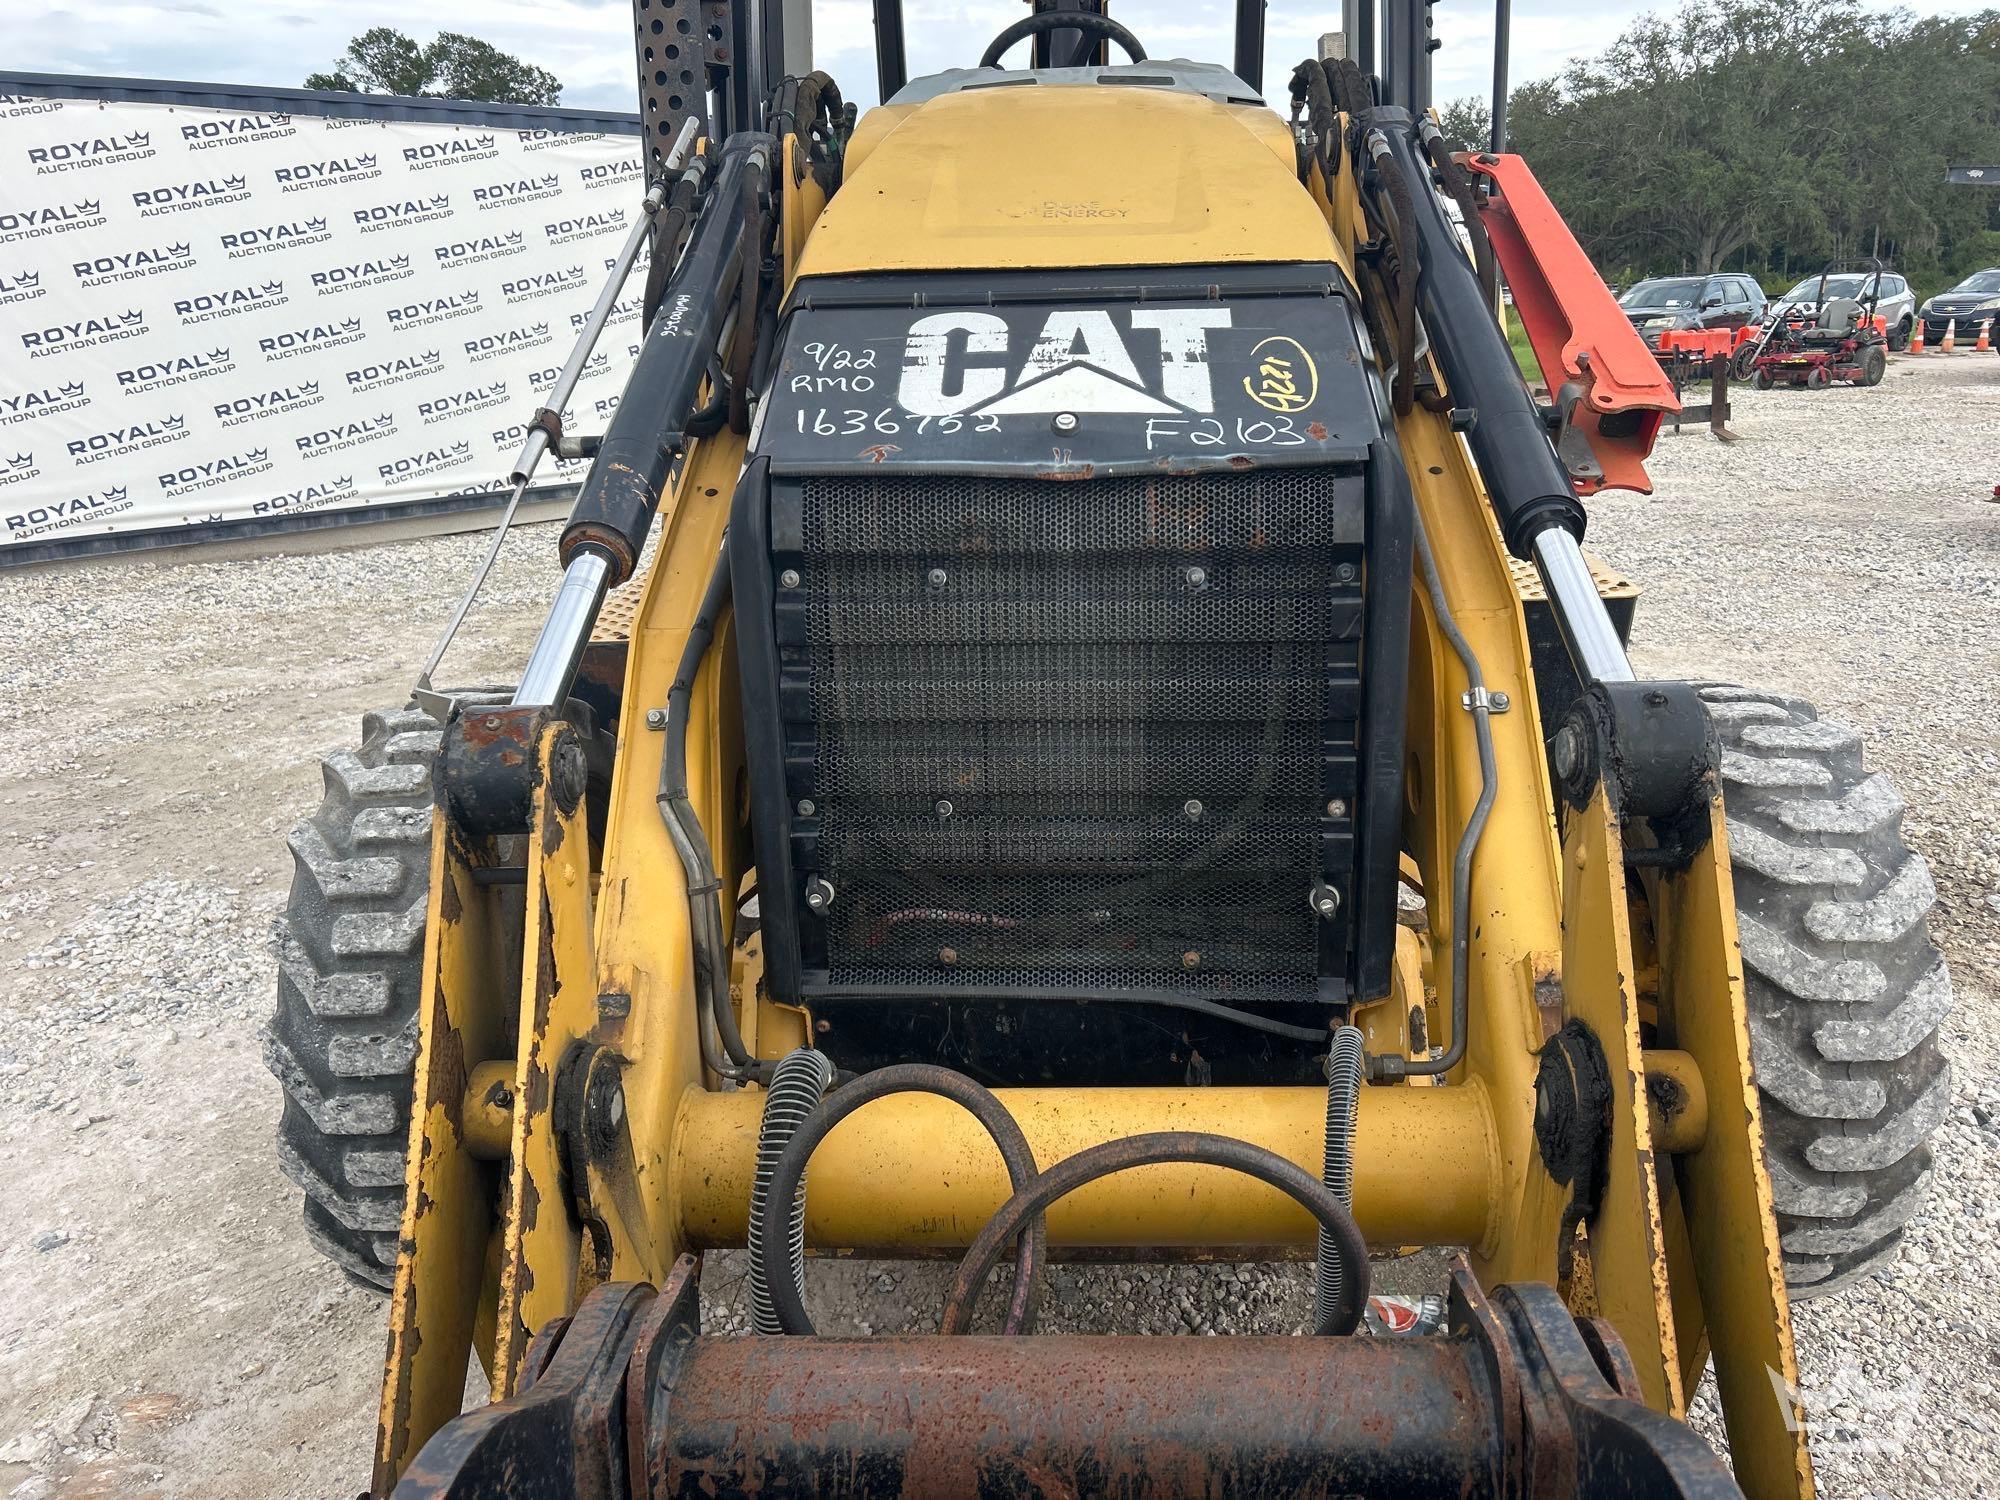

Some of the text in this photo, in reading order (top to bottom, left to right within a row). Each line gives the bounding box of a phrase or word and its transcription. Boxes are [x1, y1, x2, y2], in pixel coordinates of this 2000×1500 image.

[10, 103, 63, 116] GROUP
[181, 116, 271, 140] ROYAL
[190, 128, 296, 151] AUCTION GROUP
[28, 138, 127, 164] ROYAL
[403, 140, 477, 161] ROYAL
[524, 139, 568, 152] AUCTION
[570, 133, 606, 144] GROUP
[38, 150, 156, 175] AUCTION GROUP
[275, 159, 358, 182] ROYAL
[410, 151, 498, 171] AUCTION GROUP
[580, 160, 642, 180] ROYAL
[132, 181, 225, 207] ROYAL
[282, 170, 382, 193] AUCTION GROUP
[473, 179, 542, 201] ROYAL
[586, 177, 627, 188] AUCTION
[141, 192, 251, 217] AUCTION GROUP
[354, 200, 431, 224] ROYAL
[480, 189, 562, 210] AUCTION GROUP
[0, 206, 77, 230] OYAL
[361, 210, 454, 234] AUCTION GROUP
[545, 214, 609, 236] ROYAL
[1043, 209, 1129, 218] ENERGY
[0, 218, 106, 243] CTION GROUP
[220, 223, 307, 248] ROYAL
[550, 223, 627, 245] AUCTION GROUP
[229, 234, 332, 259] AUCTION GROUP
[435, 236, 506, 260] ROYAL
[441, 246, 526, 270] AUCTION GROUP
[73, 249, 169, 277] ROYAL
[82, 260, 196, 288] AUCTION GROUP
[311, 258, 391, 286] ROYAL
[318, 270, 414, 296] AUCTION GROUP
[502, 272, 568, 295] ROYAL
[508, 280, 587, 304] AUCTION GROUP
[174, 287, 263, 315] ROYAL
[182, 297, 288, 325] AUCTION GROUP
[387, 297, 461, 322] ROYAL
[570, 302, 632, 326] RAL
[394, 305, 482, 332] AUCTION GROUP
[21, 317, 121, 348] ROYAL
[31, 327, 149, 359] AUCTION GROUP
[259, 325, 342, 352] ROYAL
[464, 329, 533, 354] ROYAL
[267, 333, 366, 362] AUCTION GROUP
[470, 336, 552, 362] AUCTION GROUP
[804, 342, 876, 371] 9/22
[116, 355, 209, 385] ROYAL
[346, 357, 422, 384] ROYAL
[898, 307, 1231, 416] CAT
[125, 364, 236, 396] AUCTION GROUP
[353, 365, 444, 394] AUCTION GROUP
[791, 374, 874, 392] RMO
[0, 390, 61, 414] YAL
[0, 398, 90, 425] TION GROUP
[214, 388, 300, 418] ROYAL
[222, 396, 324, 428] AUCTION GROUP
[418, 389, 490, 416] ROYAL
[424, 396, 510, 424] AUCTION GROUP
[797, 407, 1002, 436] 1636752
[1146, 416, 1306, 450] F2103
[67, 423, 162, 456] ROYAL
[76, 431, 190, 466] AUCTION GROUP
[296, 421, 375, 450] ROYAL
[303, 428, 398, 460] AUCTION GROUP
[158, 456, 248, 488] ROYAL
[378, 449, 452, 478] ROYAL
[386, 455, 473, 486] AUCTION GROUP
[167, 463, 273, 498] AUCTION GROUP
[448, 476, 512, 496] OYAL
[253, 484, 334, 514] ROYAL
[273, 490, 358, 515] CTION GROUP
[6, 496, 104, 530] ROYAL
[15, 502, 133, 540] AUCTION GROUP
